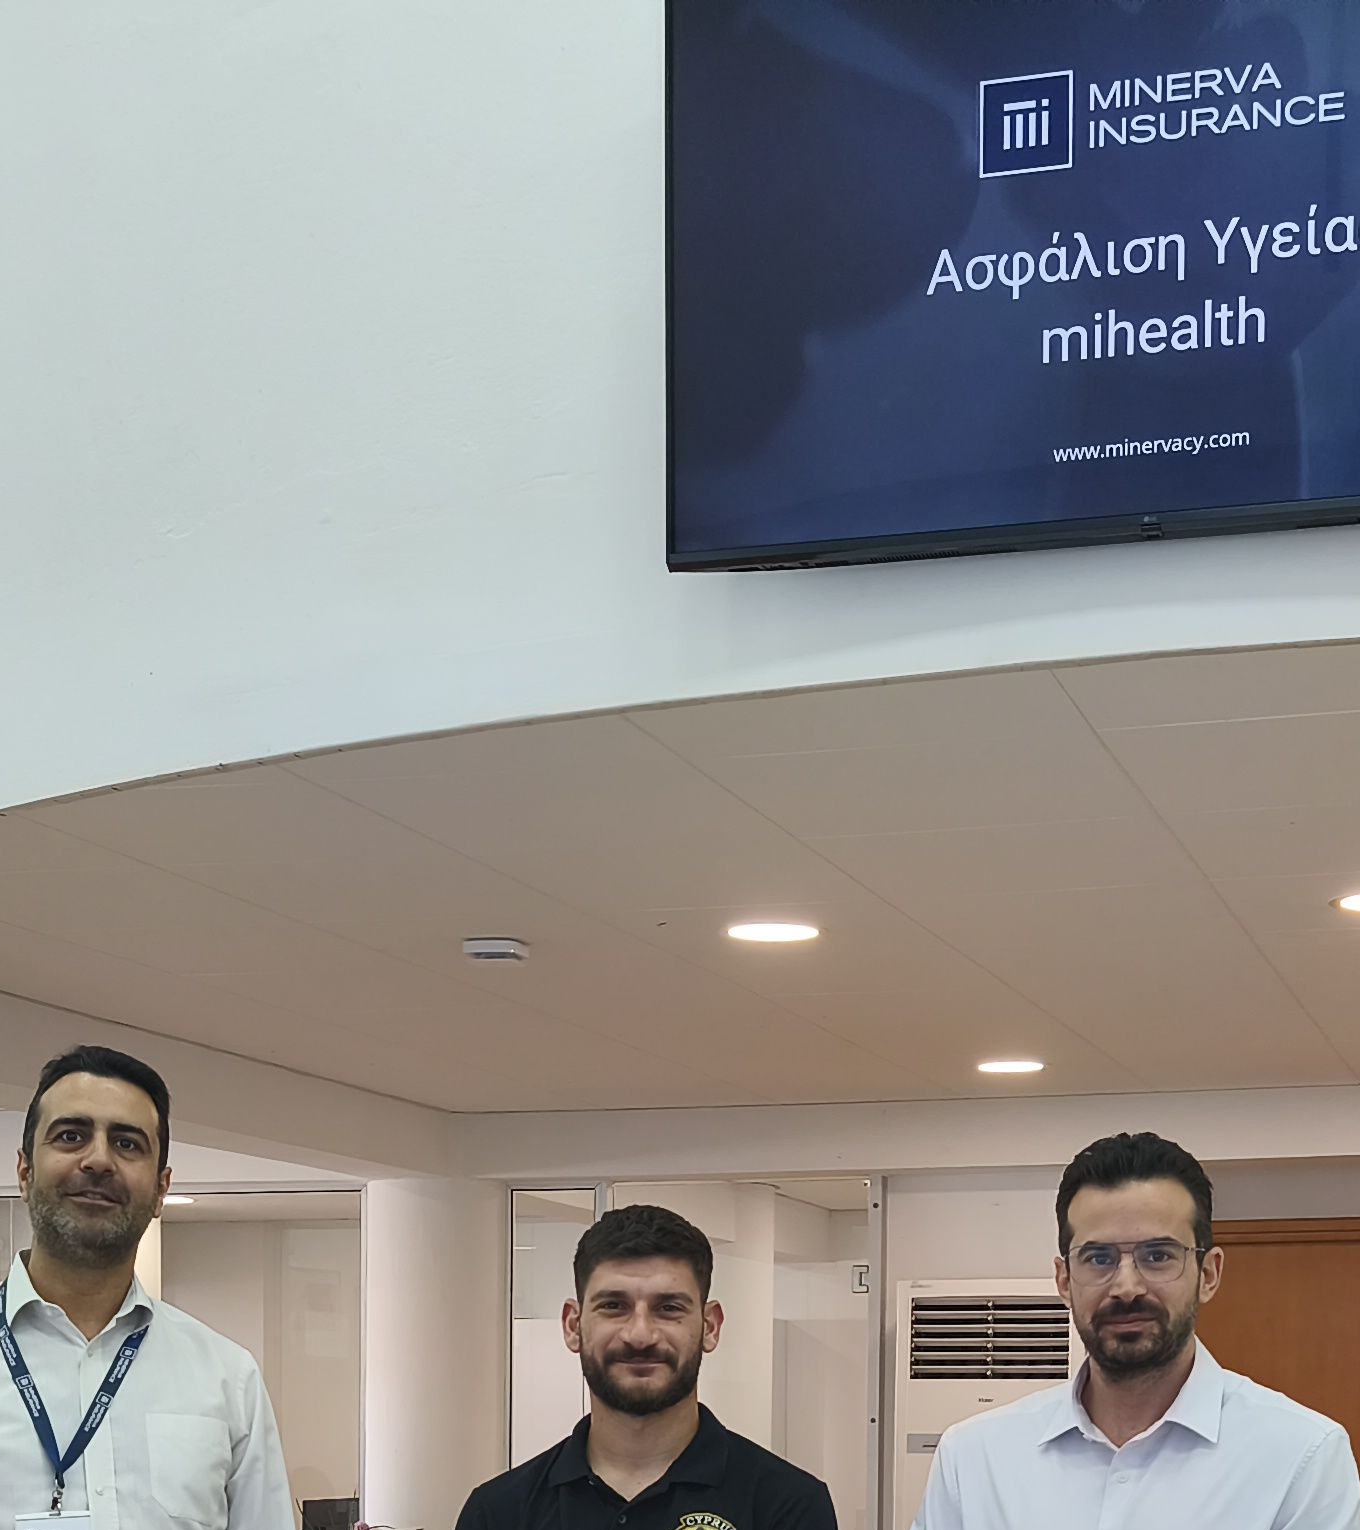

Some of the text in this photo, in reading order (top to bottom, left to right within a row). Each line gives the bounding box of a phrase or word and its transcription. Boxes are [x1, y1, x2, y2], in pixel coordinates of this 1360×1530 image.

[1089, 62, 1282, 111] MINERVA
[1089, 91, 1346, 149] INSURANCE
[926, 231, 1186, 300] Ασφάλιση
[1042, 295, 1267, 364] mihealth
[1053, 430, 1251, 462] www.minervacy.com
